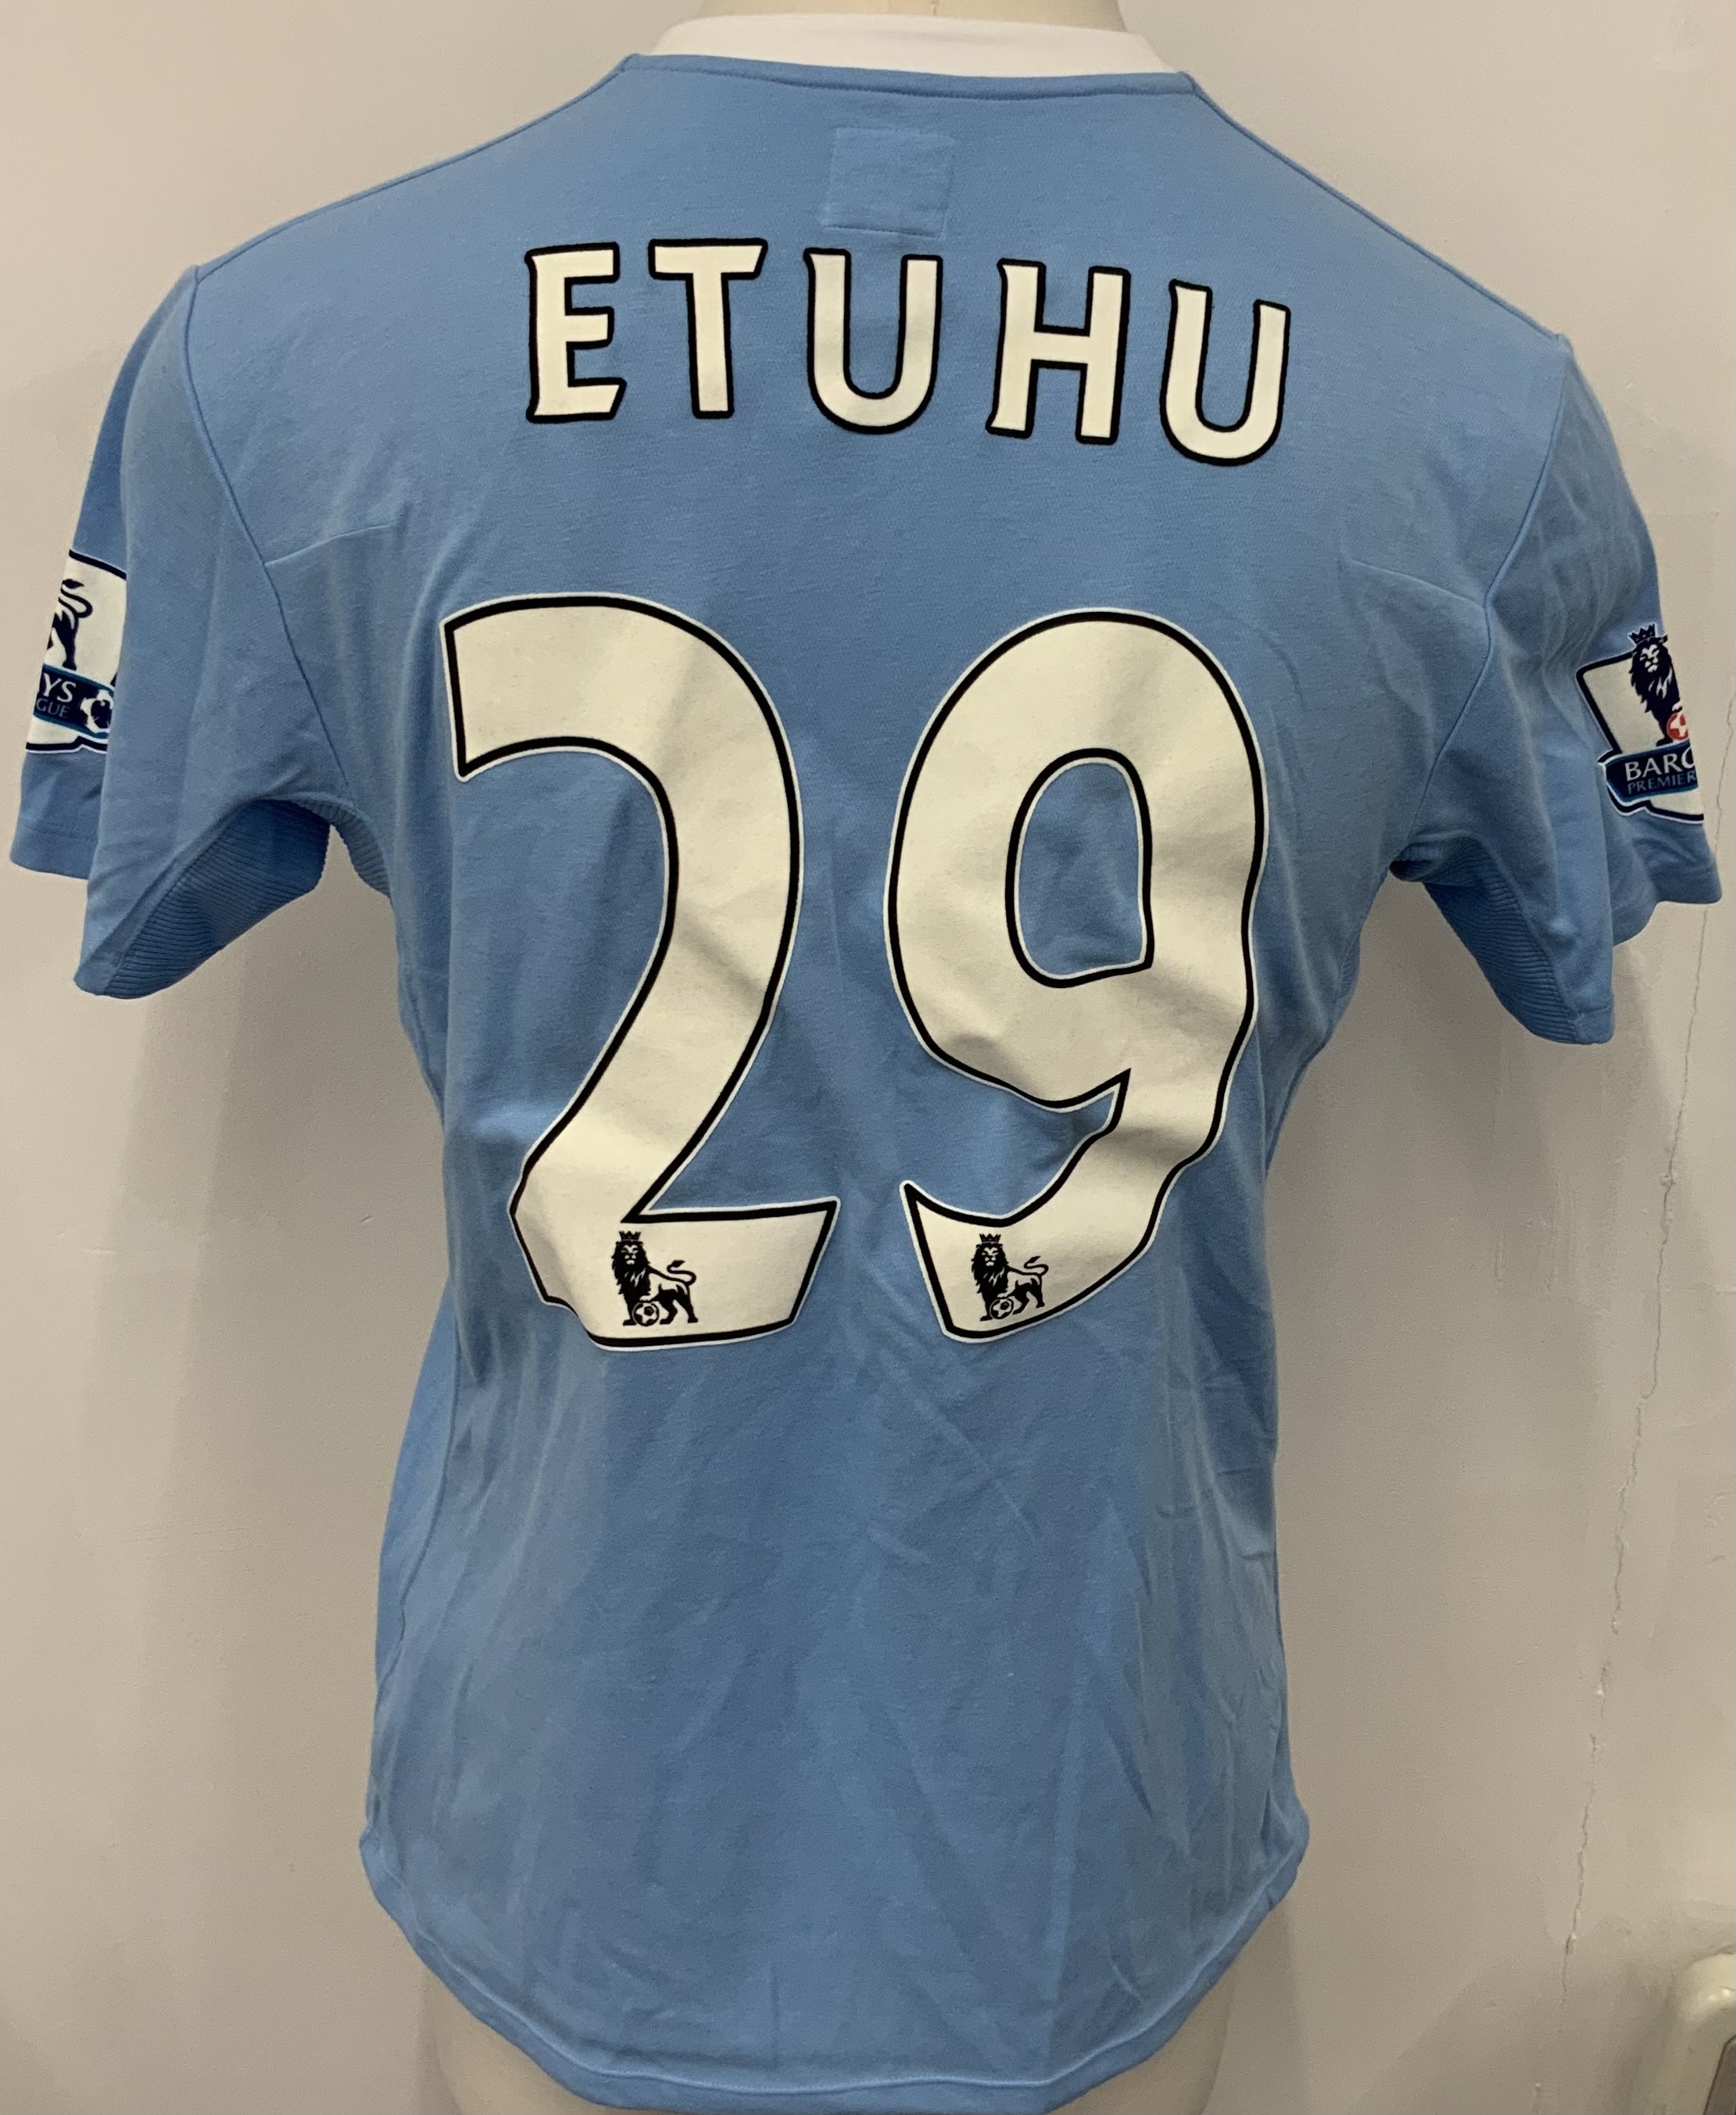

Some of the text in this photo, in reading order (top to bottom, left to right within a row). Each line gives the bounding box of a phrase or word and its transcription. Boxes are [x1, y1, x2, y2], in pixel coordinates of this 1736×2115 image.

[525, 238, 1291, 464] ETUHU
[1628, 771, 1696, 794] PREMIER
[442, 594, 1268, 1346] 29
